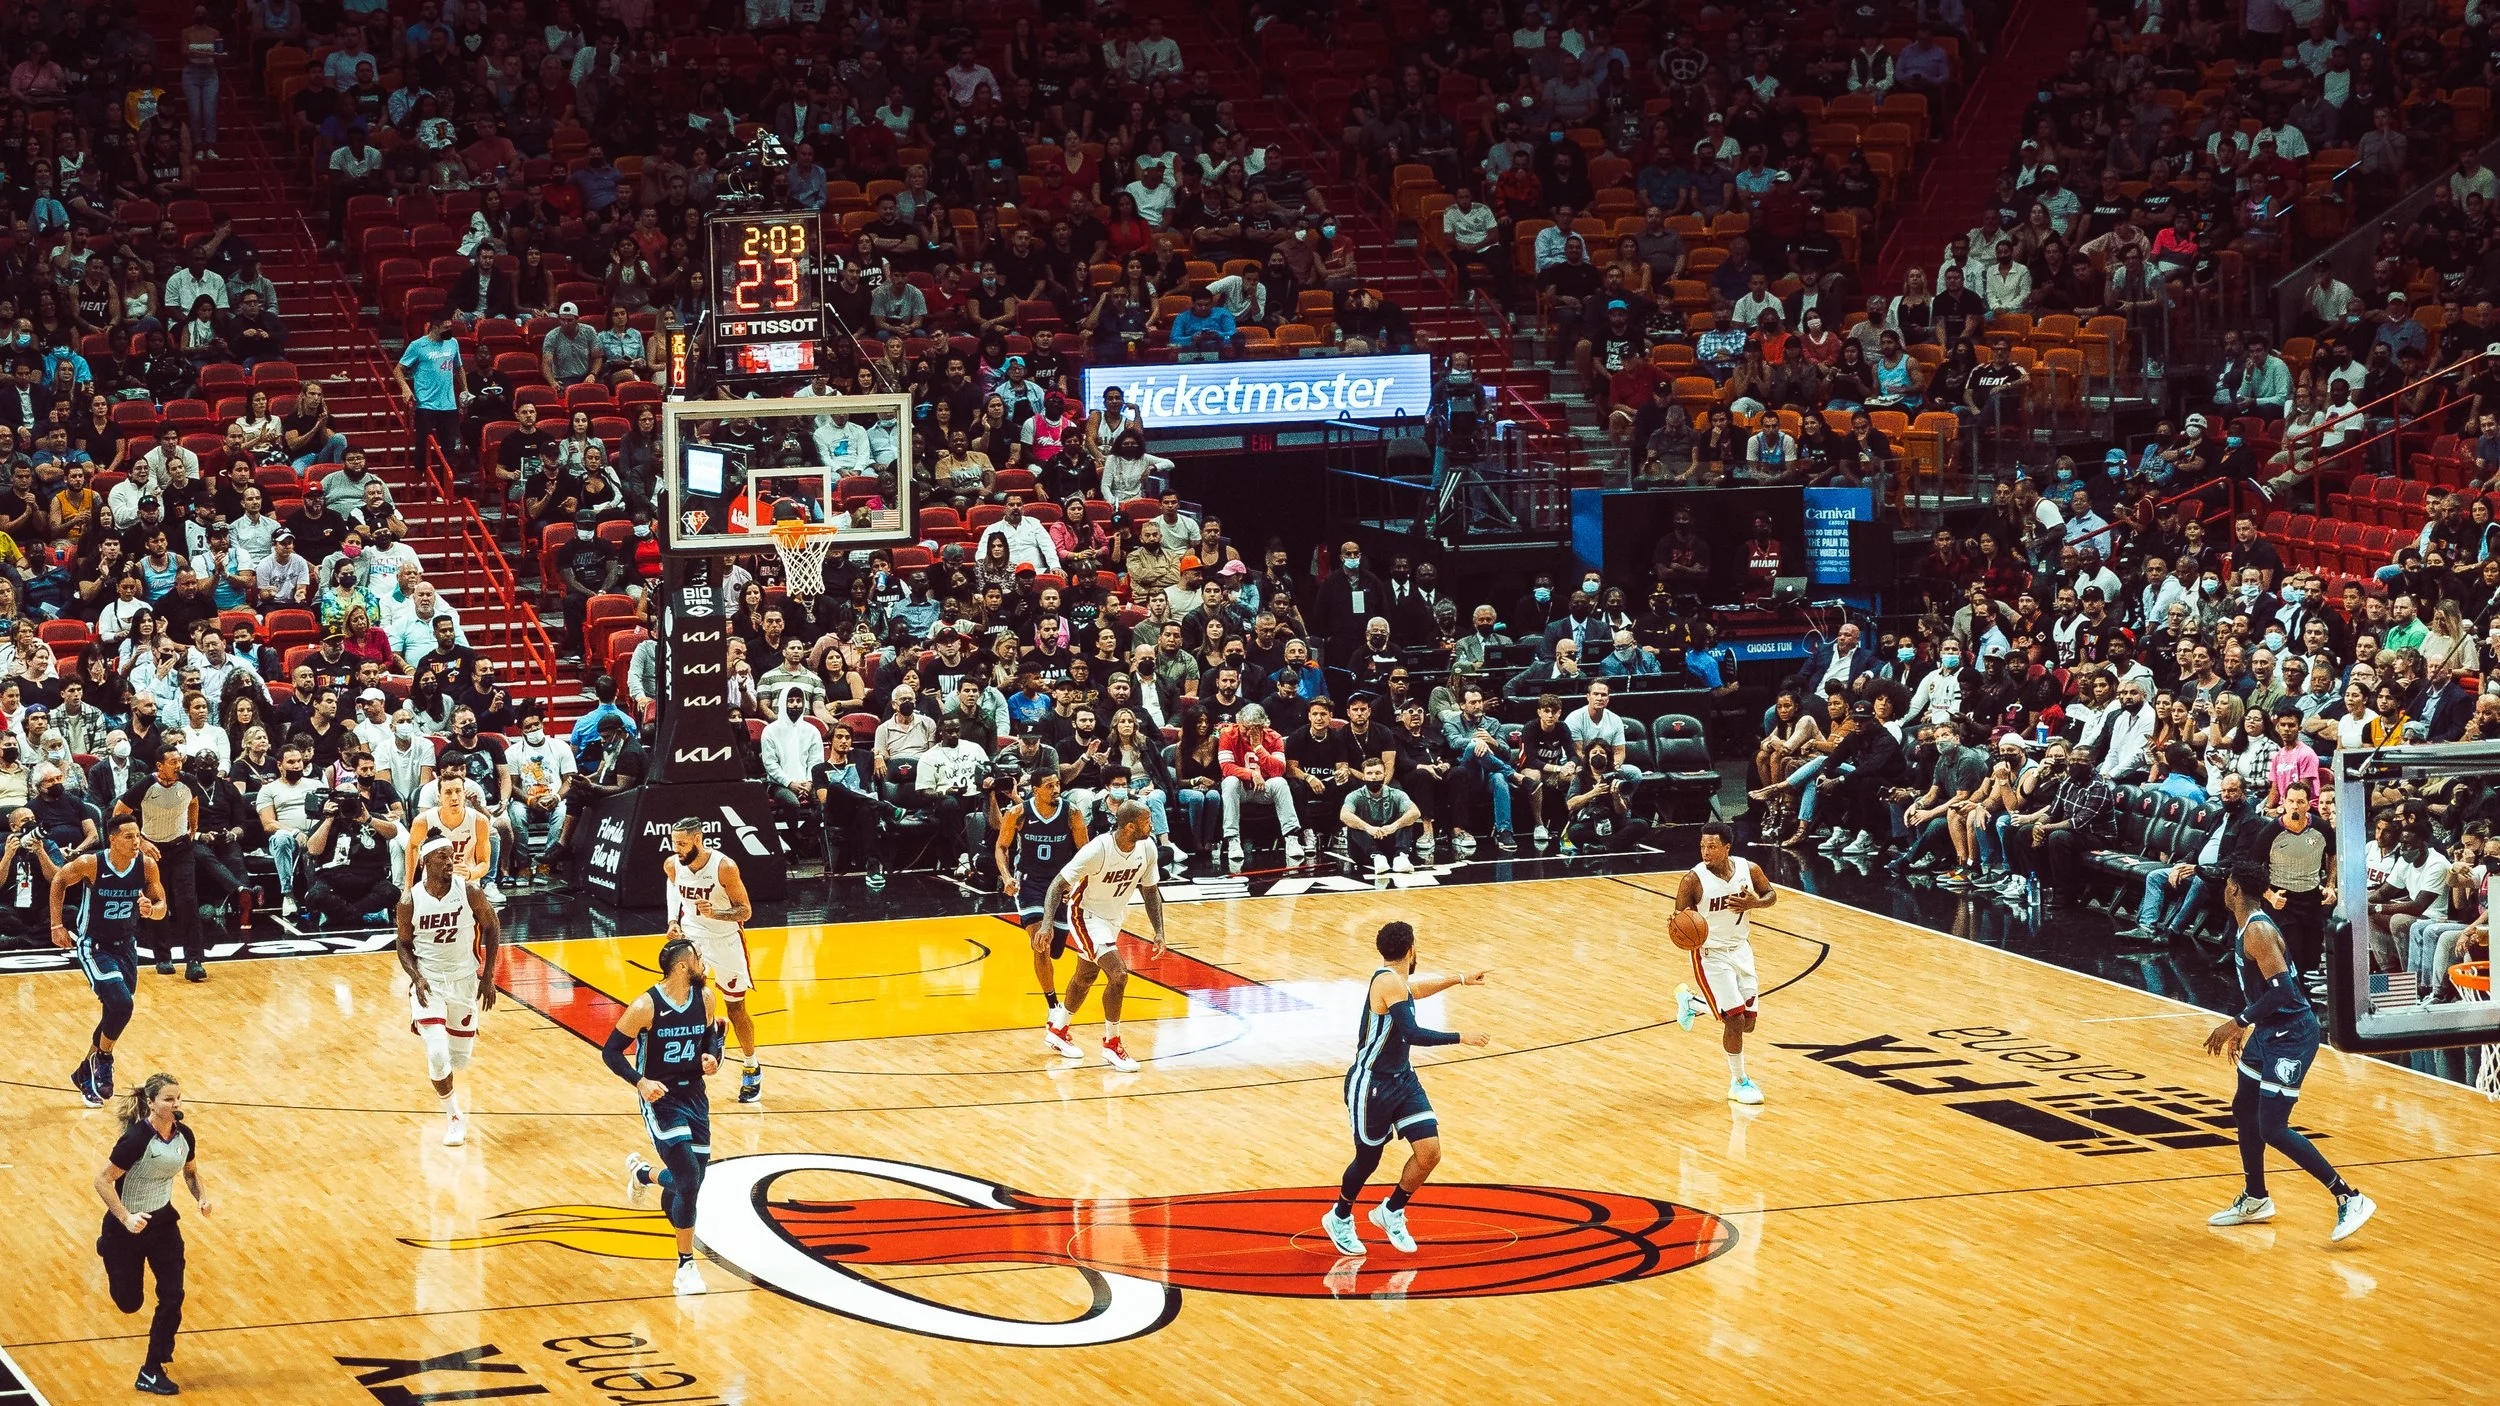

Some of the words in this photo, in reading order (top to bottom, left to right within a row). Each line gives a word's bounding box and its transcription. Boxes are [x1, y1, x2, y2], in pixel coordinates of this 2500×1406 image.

[744, 225, 806, 257] 2:03
[736, 257, 798, 309] 23
[869, 275, 882, 286] 22
[80, 300, 109, 313] HEAT
[746, 317, 818, 335] TISSOT
[1035, 366, 1059, 378] HEAT
[1979, 375, 2009, 387] HEAT
[1123, 372, 1395, 419] ticketmaster
[1804, 507, 1857, 521] Carnival
[196, 534, 204, 549] 3
[1749, 559, 1780, 569] MIAMI
[682, 587, 713, 600] BIO
[1746, 643, 1775, 654] CHOOSE
[1777, 642, 1793, 653] FUN
[674, 745, 732, 763] KIA
[596, 816, 625, 844] Florida
[1023, 833, 1069, 844] GRIZZLIES
[590, 843, 609, 868] Blue
[1037, 844, 1054, 861] 0
[1101, 863, 1143, 885] HEAT
[679, 883, 717, 901] HEAT
[1112, 880, 1133, 898] 17
[103, 900, 134, 920] 22
[419, 905, 464, 930] HEAT
[433, 927, 459, 945] 22
[656, 1024, 706, 1040] GRIZZLIES
[663, 1039, 697, 1064] 24
[1927, 1026, 2147, 1082] arena
[1768, 1033, 2039, 1096] FTX
